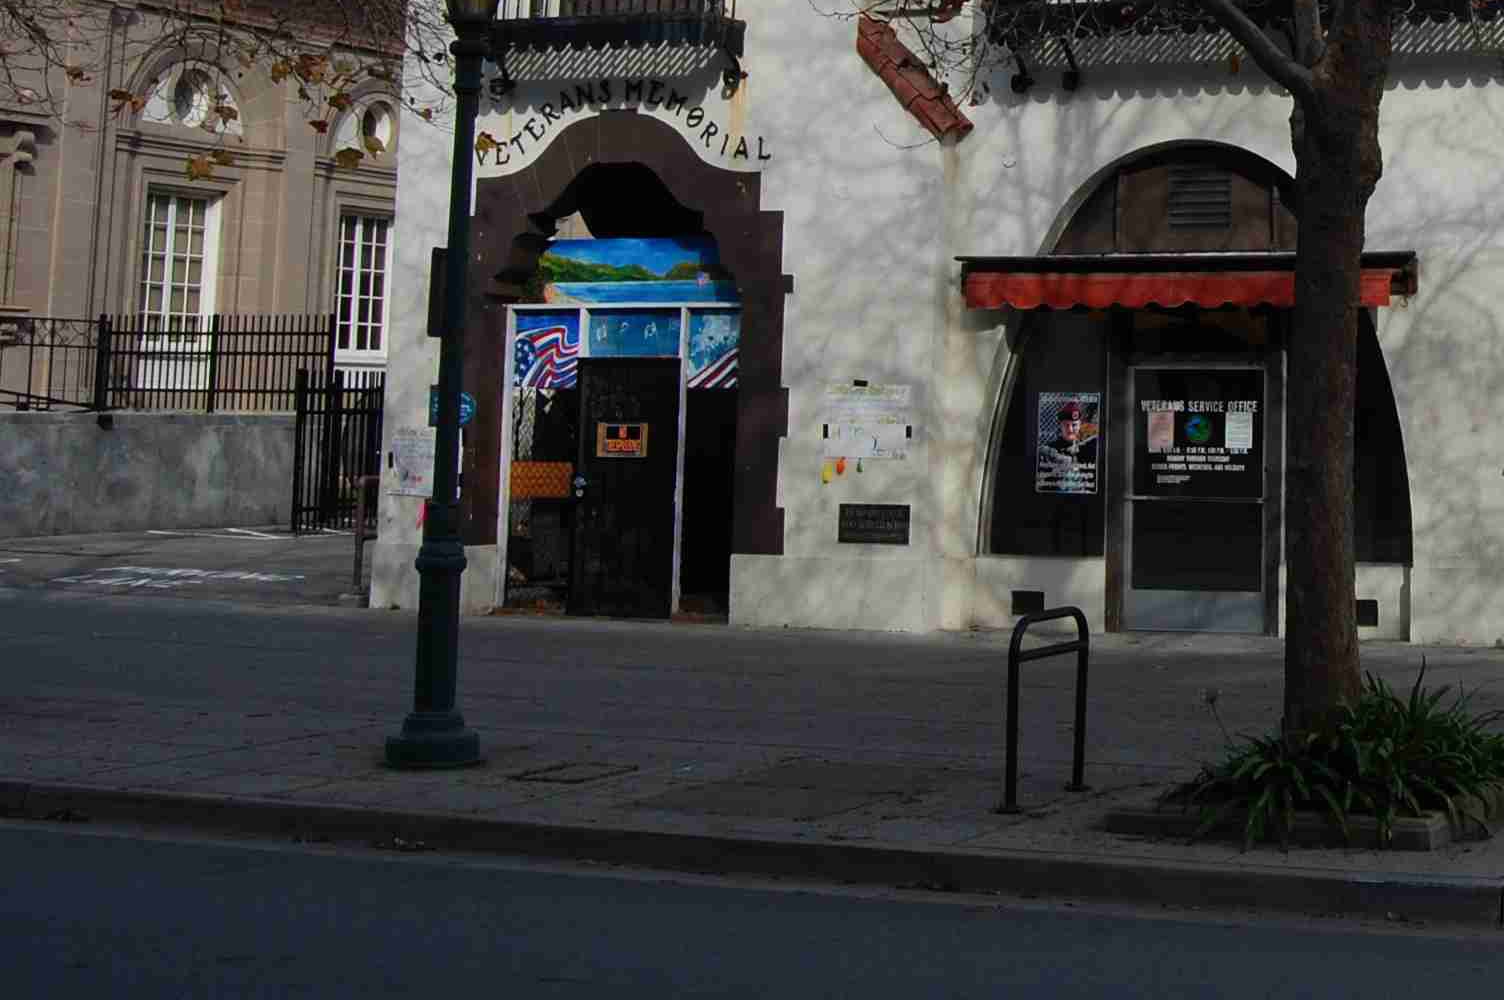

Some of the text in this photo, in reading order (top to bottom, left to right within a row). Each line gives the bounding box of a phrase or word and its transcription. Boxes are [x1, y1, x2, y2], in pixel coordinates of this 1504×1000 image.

[475, 79, 772, 166] VETERANS MEMORIAL
[1188, 400, 1224, 412] SERVICE
[1228, 400, 1258, 412] OFFICE
